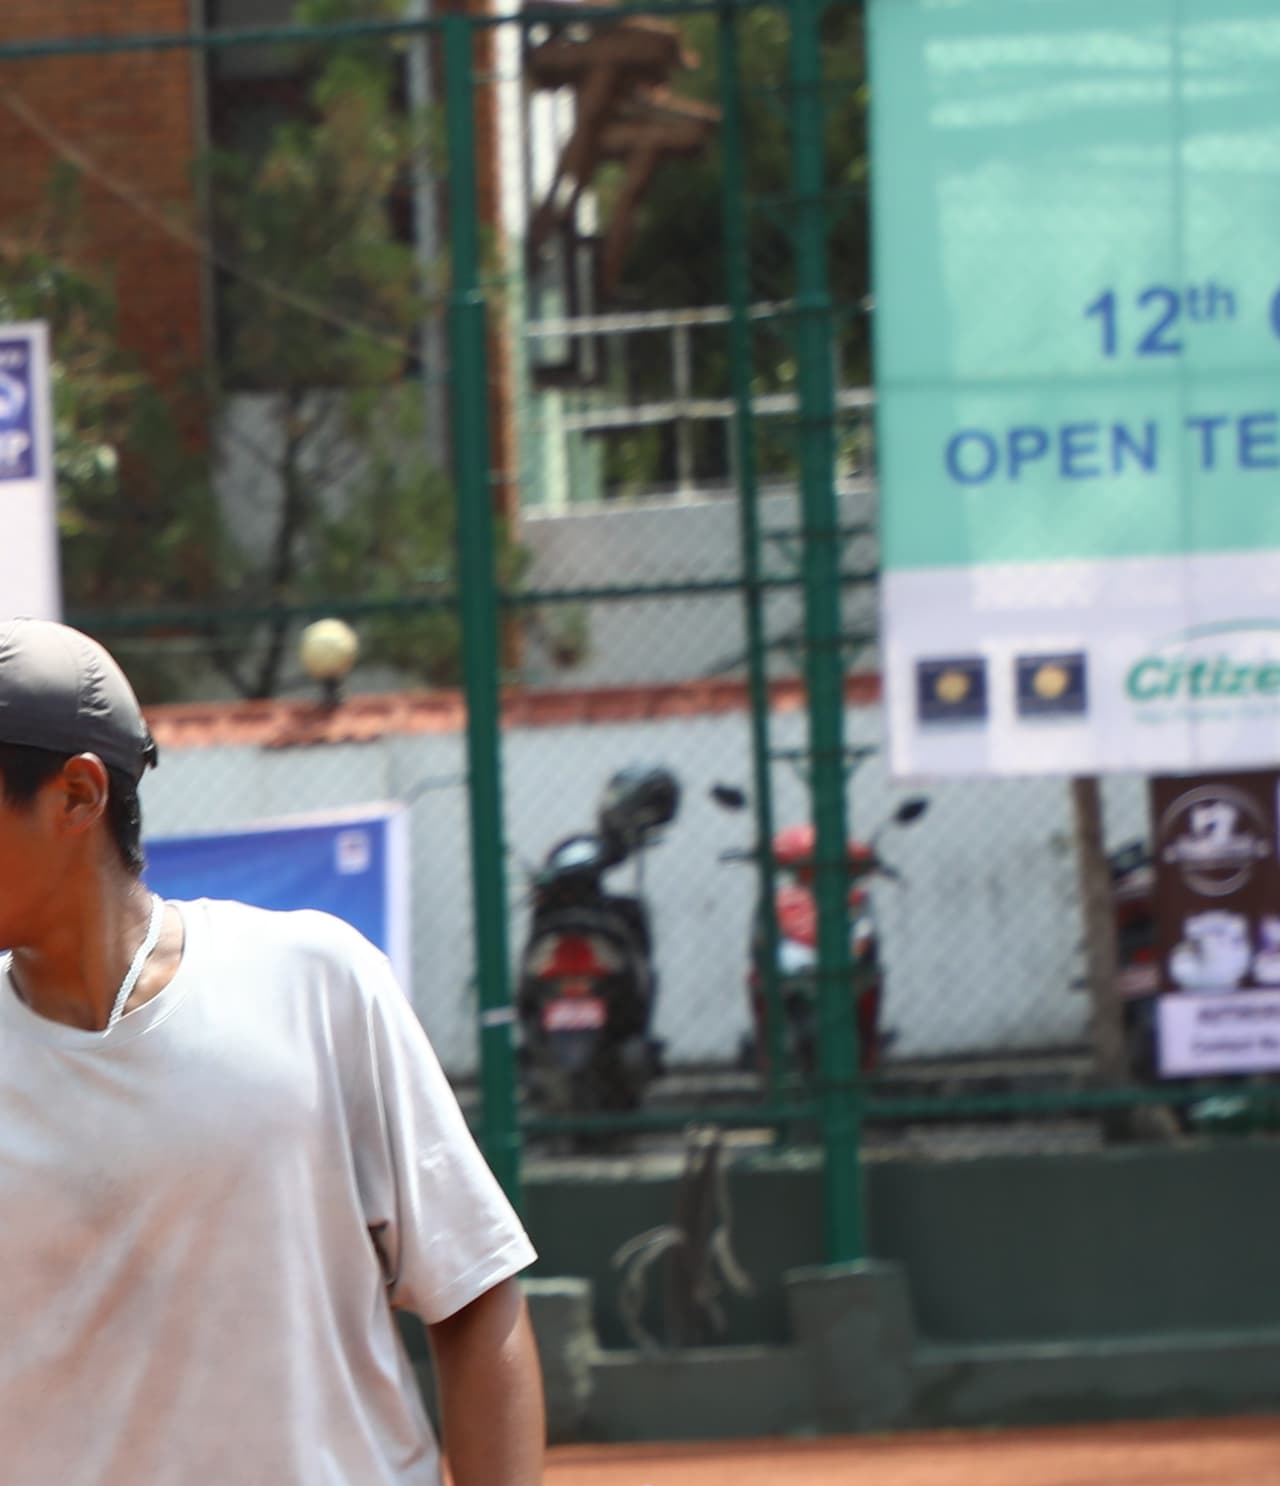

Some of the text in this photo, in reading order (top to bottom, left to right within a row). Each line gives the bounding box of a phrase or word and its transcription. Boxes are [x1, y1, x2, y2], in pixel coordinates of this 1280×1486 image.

[1084, 281, 1236, 358] 12th
[945, 411, 1280, 486] OPEN TE
